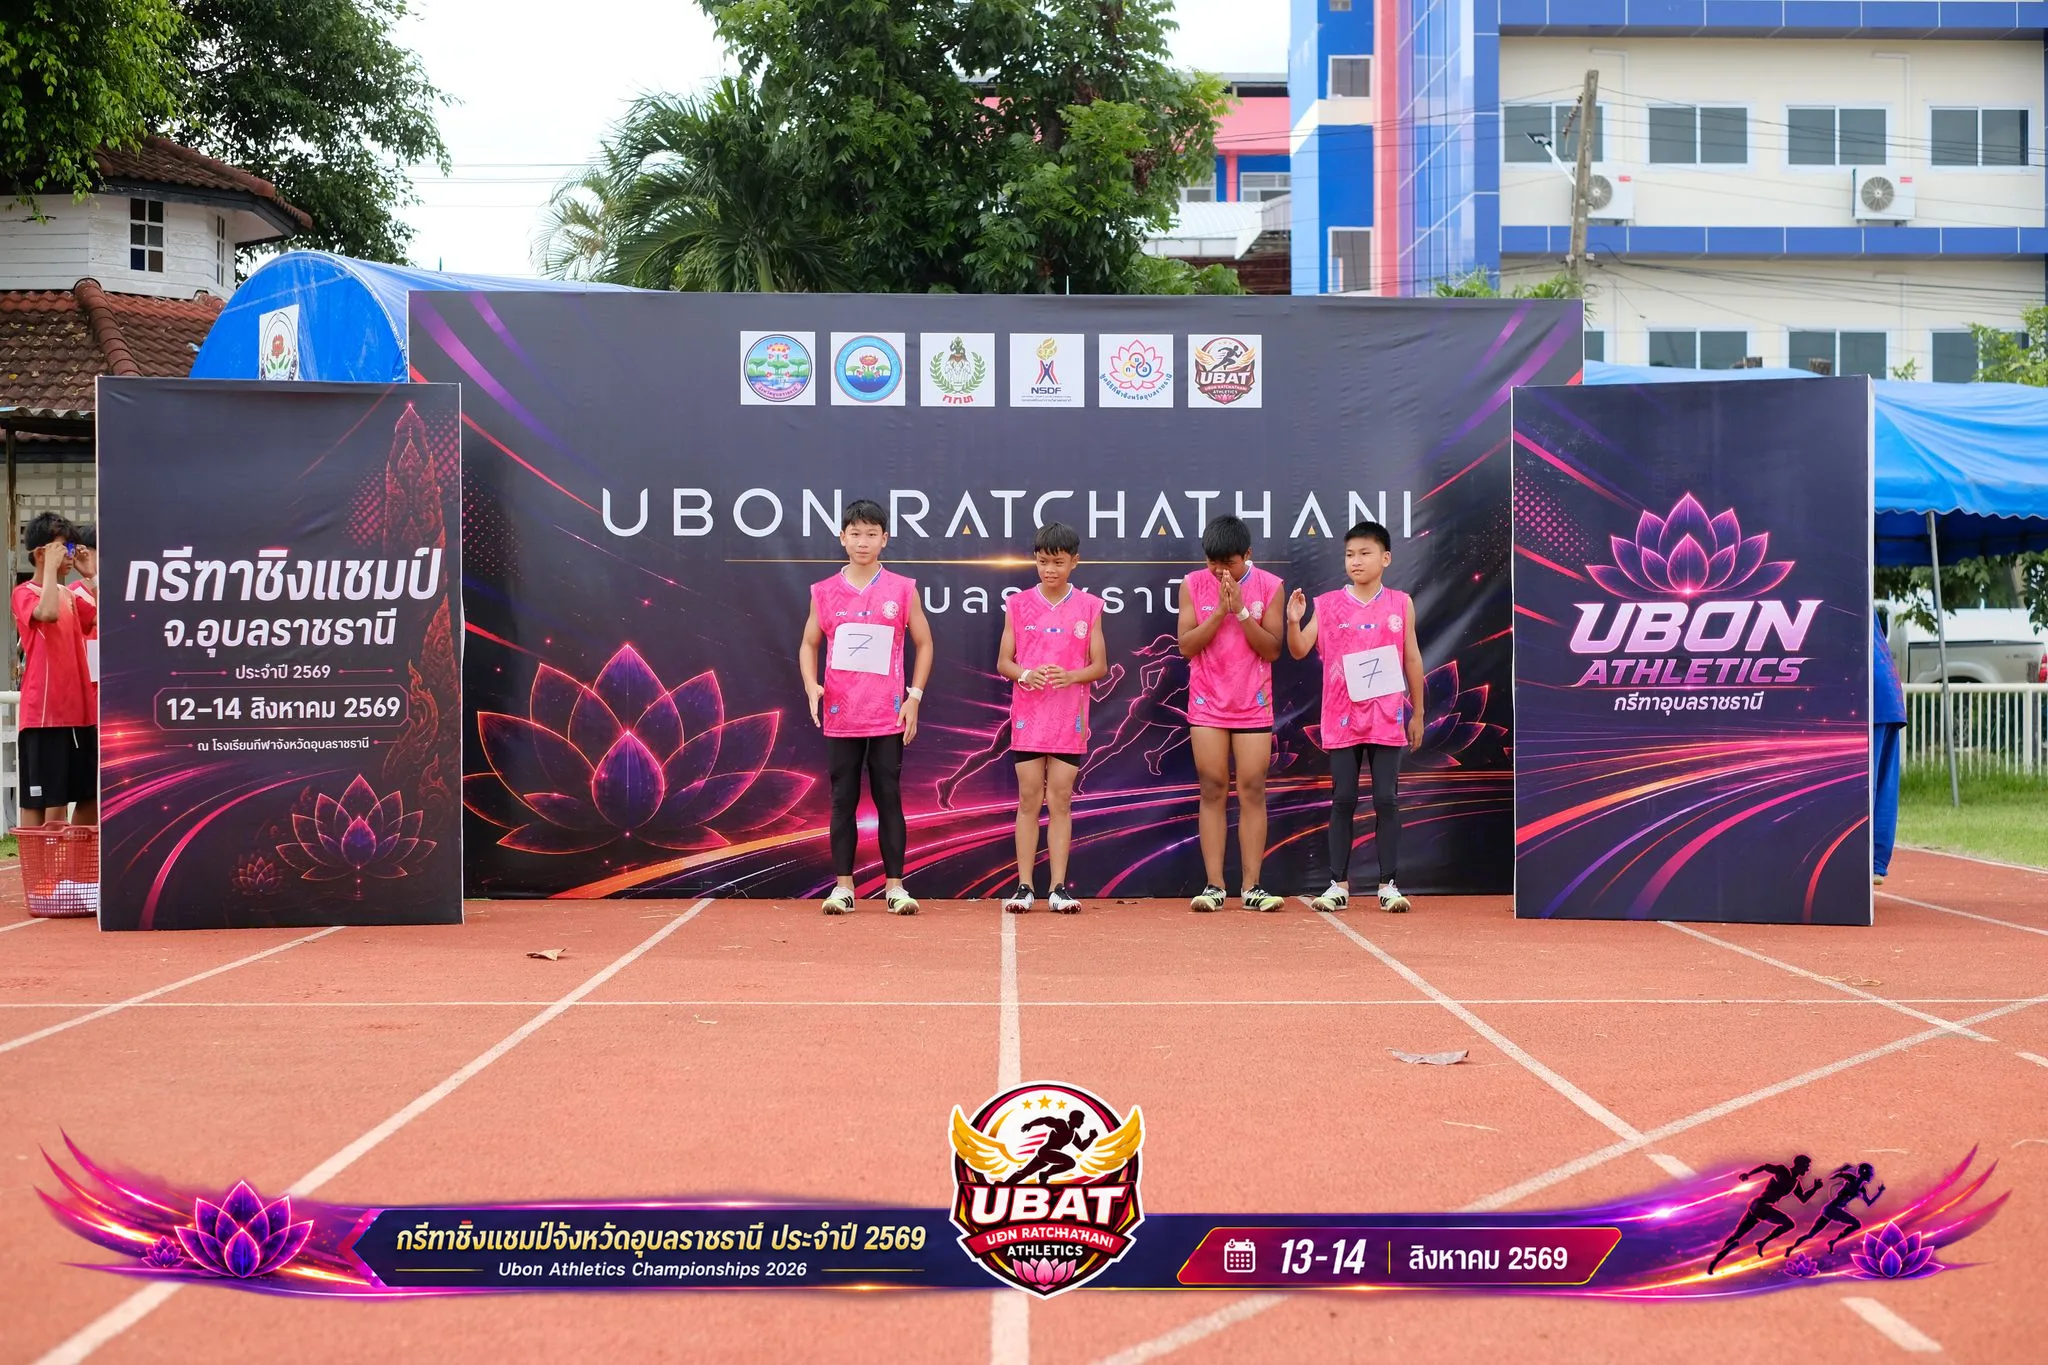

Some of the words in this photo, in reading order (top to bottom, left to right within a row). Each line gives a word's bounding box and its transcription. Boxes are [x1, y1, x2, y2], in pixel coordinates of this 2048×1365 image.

[1031, 387, 1061, 395] NSDF
[1200, 372, 1250, 385] UBAT
[603, 488, 841, 537] UBON
[890, 490, 1411, 538] RATCHATHANI
[126, 547, 442, 602] กรีฑาชิงแชมป์
[163, 608, 397, 658] จ.อุบลราชธานี
[1570, 600, 1823, 653] UBON
[847, 633, 873, 657] 7
[235, 663, 288, 680] ประจำปี
[292, 664, 331, 679] 2569
[1358, 658, 1383, 688] 7
[1572, 657, 1815, 687] ATHLETICS
[250, 697, 336, 720] สิงหาคม
[343, 697, 401, 718] 2569
[1613, 690, 1765, 716] กรีฑาอุบลราชธานี
[197, 742, 209, 752] ณ
[212, 737, 370, 753] โรงเรียนกีฬาจังหวัดอุบลราชธานี
